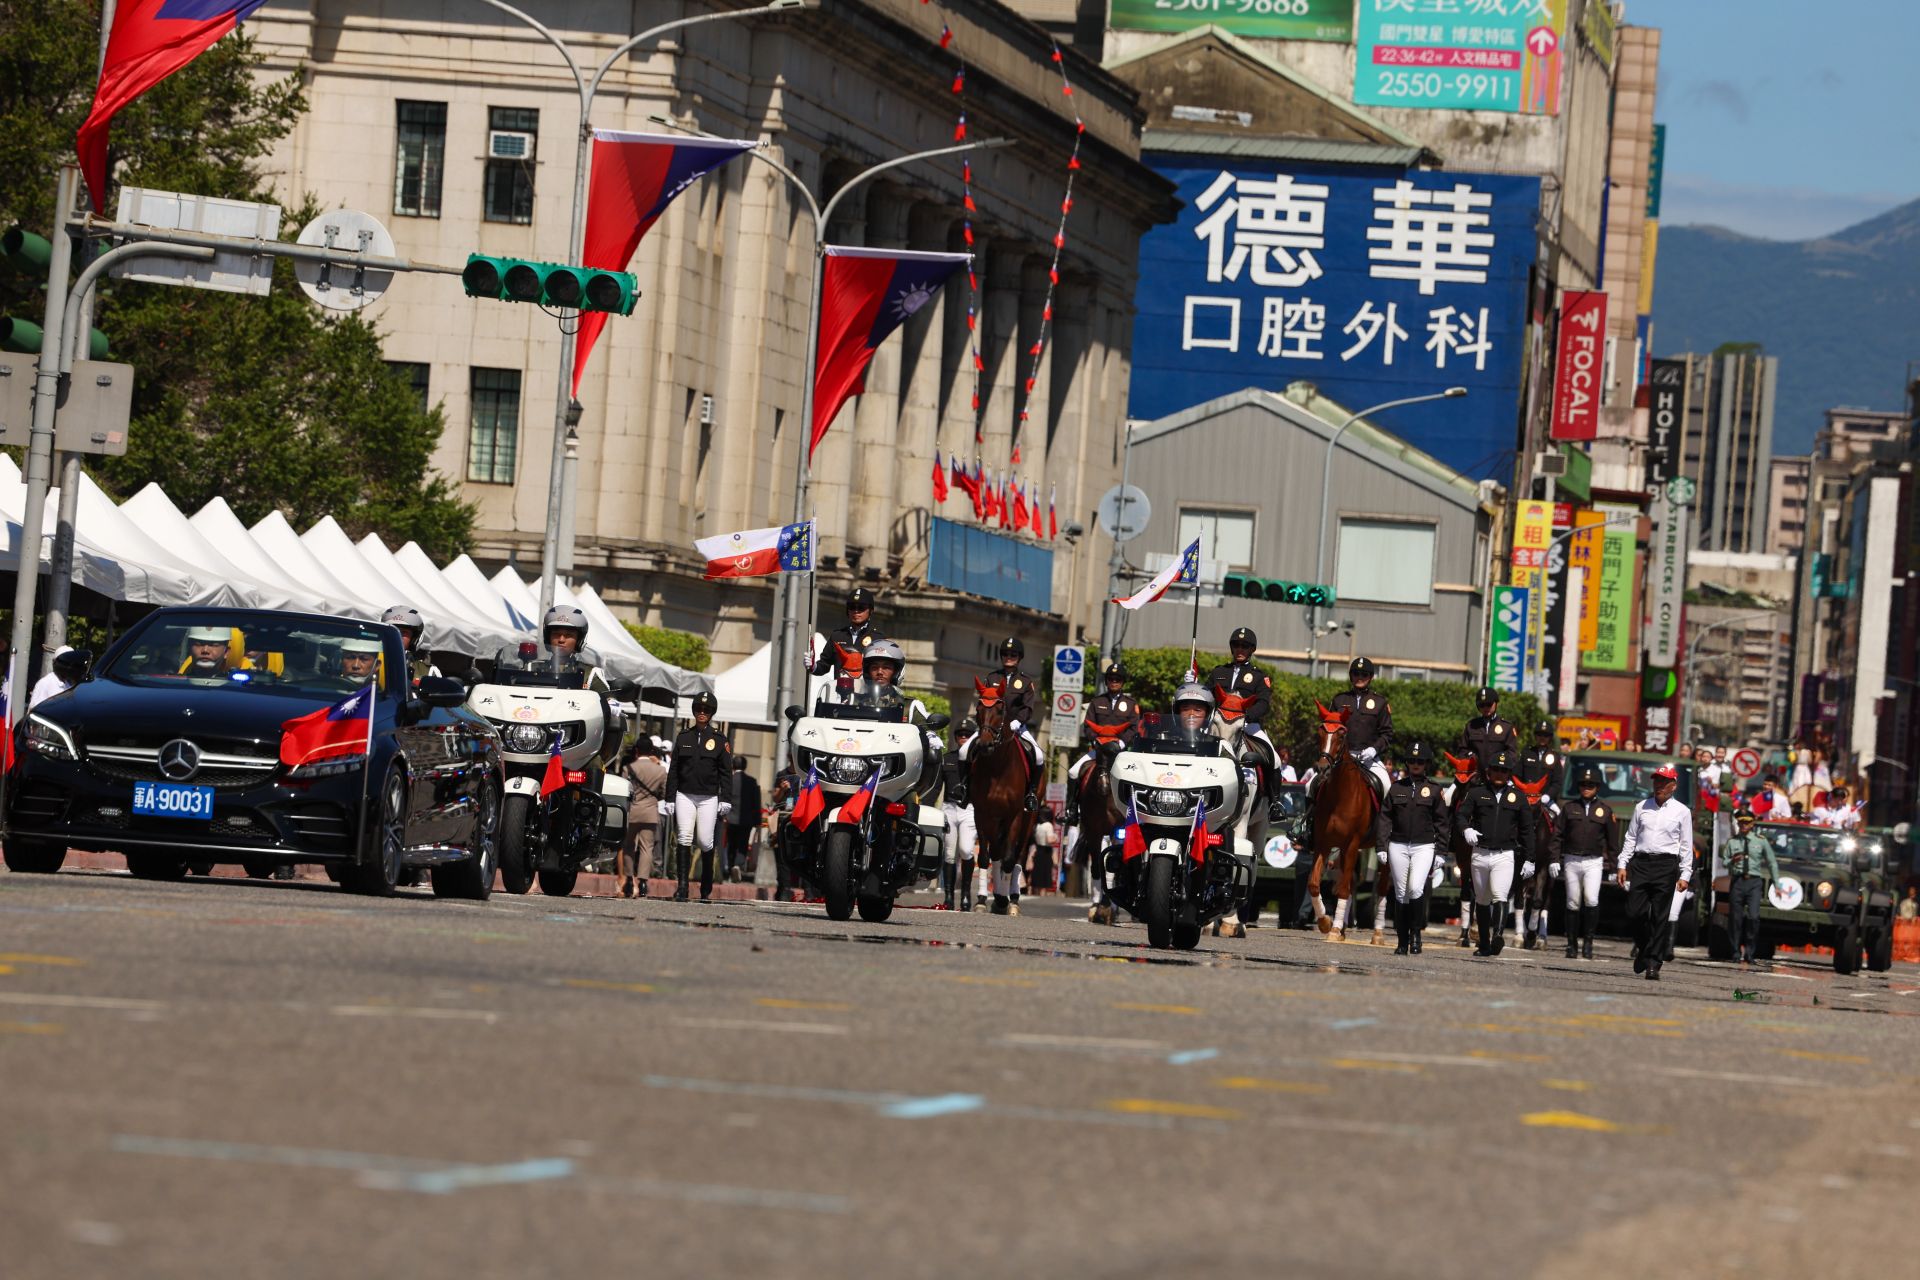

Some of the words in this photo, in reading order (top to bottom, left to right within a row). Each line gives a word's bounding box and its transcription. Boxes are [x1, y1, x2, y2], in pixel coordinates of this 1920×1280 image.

[1378, 71, 1511, 100] 2550-9911
[1182, 295, 1493, 371] 口腔外科
[1568, 336, 1596, 424] FOCAL
[1523, 525, 1543, 544] 租
[1662, 503, 1678, 595] STARBUCKS
[1597, 537, 1623, 663] 西門子助聽器
[1658, 601, 1672, 656] COFFEE
